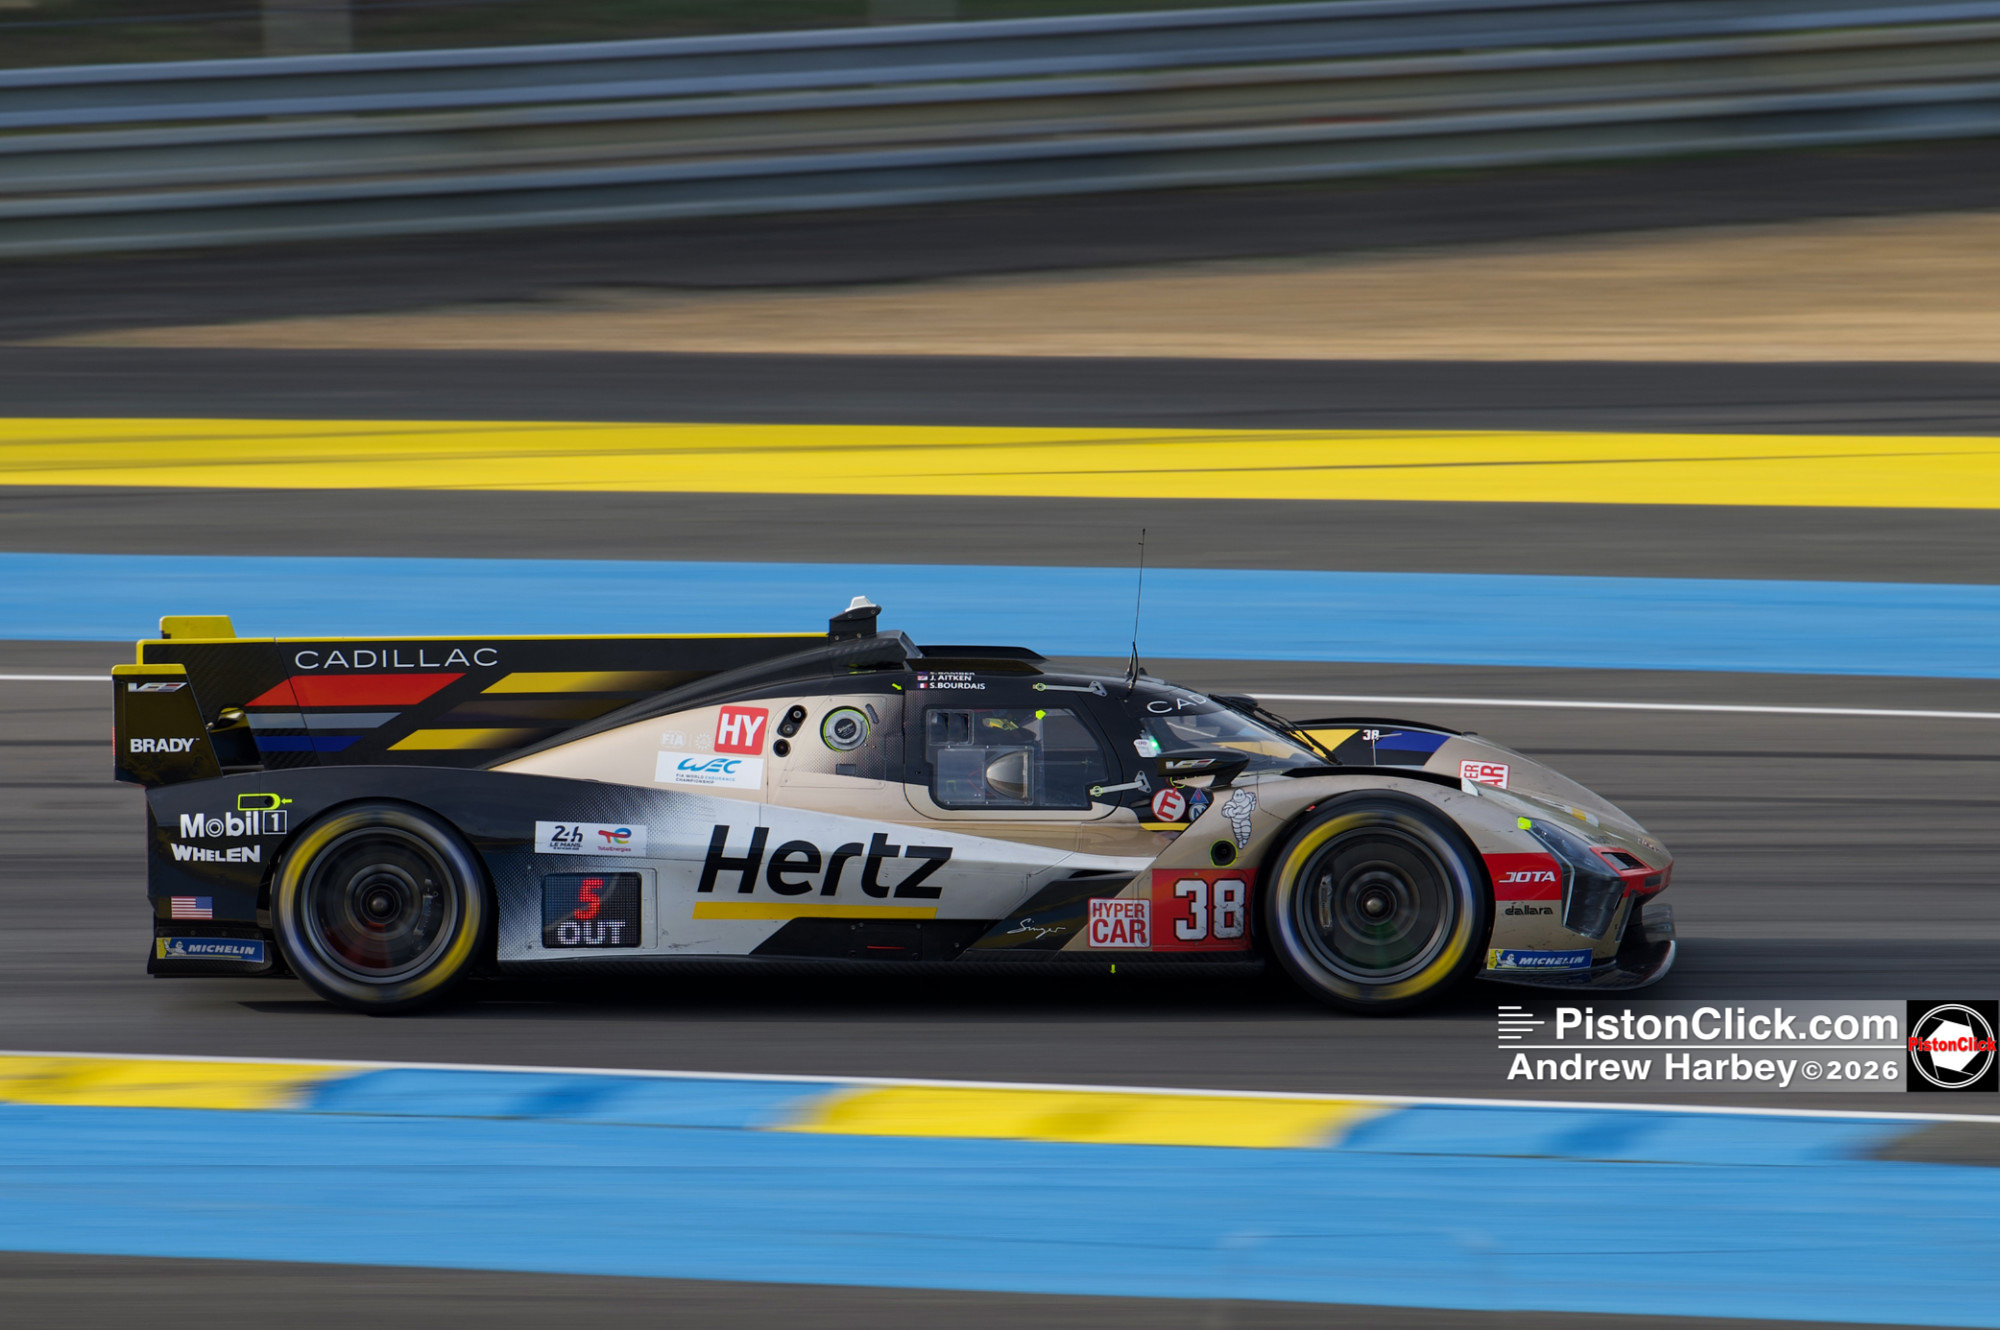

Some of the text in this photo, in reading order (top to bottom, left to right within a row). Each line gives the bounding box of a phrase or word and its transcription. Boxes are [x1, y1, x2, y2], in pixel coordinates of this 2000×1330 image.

[294, 647, 498, 669] CADILLAC
[717, 713, 765, 747] HY
[130, 738, 194, 753] BRADY
[677, 757, 742, 774] WEC
[180, 811, 260, 839] Mobil
[171, 843, 261, 863] WHELEN
[697, 824, 953, 899] Hertz
[1499, 871, 1556, 883] JOTA
[573, 877, 604, 920] 5
[1092, 903, 1146, 919] HYPER
[1173, 878, 1246, 941] 38
[1505, 905, 1554, 916] dallara
[557, 921, 626, 945] OUT
[1092, 918, 1147, 944] CAR
[188, 944, 256, 955] MICHELIN
[1518, 955, 1585, 967] MICHELIN
